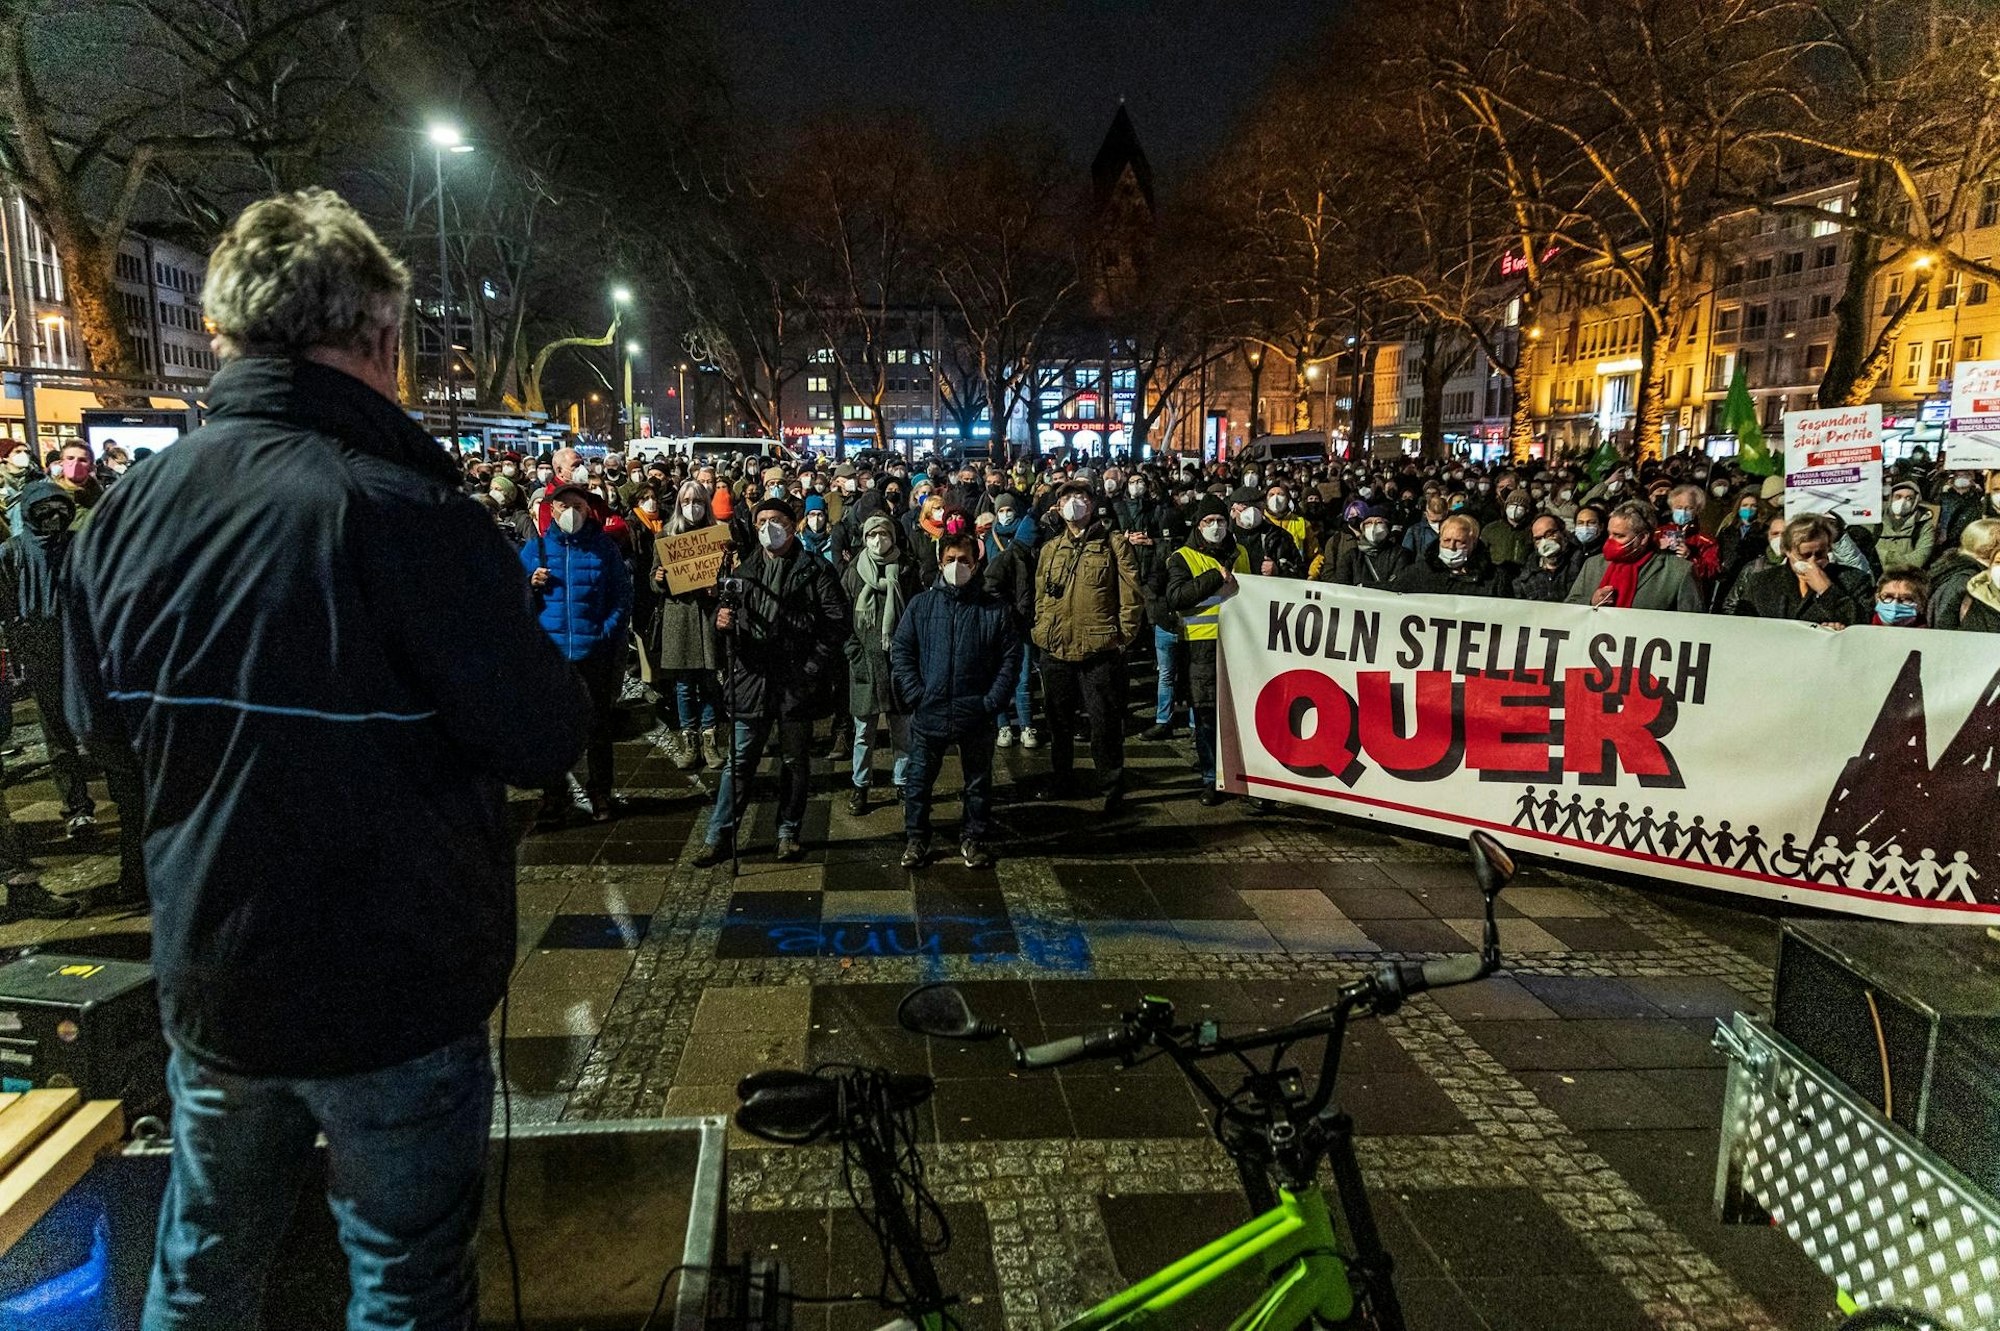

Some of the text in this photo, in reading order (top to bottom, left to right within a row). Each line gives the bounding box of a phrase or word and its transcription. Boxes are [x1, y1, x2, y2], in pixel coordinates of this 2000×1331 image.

[1797, 411, 1868, 431] Gesundheit
[1793, 429, 1873, 448] statt Profite
[1813, 448, 1872, 459] PATENTE FREIGEBEN
[1836, 454, 1872, 464] IMPFSTOFFE
[1793, 469, 1853, 480] PHARMA-KONZERNE
[664, 532, 709, 550] WER MIT
[668, 547, 695, 562] NAZIS
[672, 556, 720, 576] HAT NICHT
[1267, 590, 1711, 705] KÖLN STELLT SICH
[1255, 667, 1686, 788] QUER
